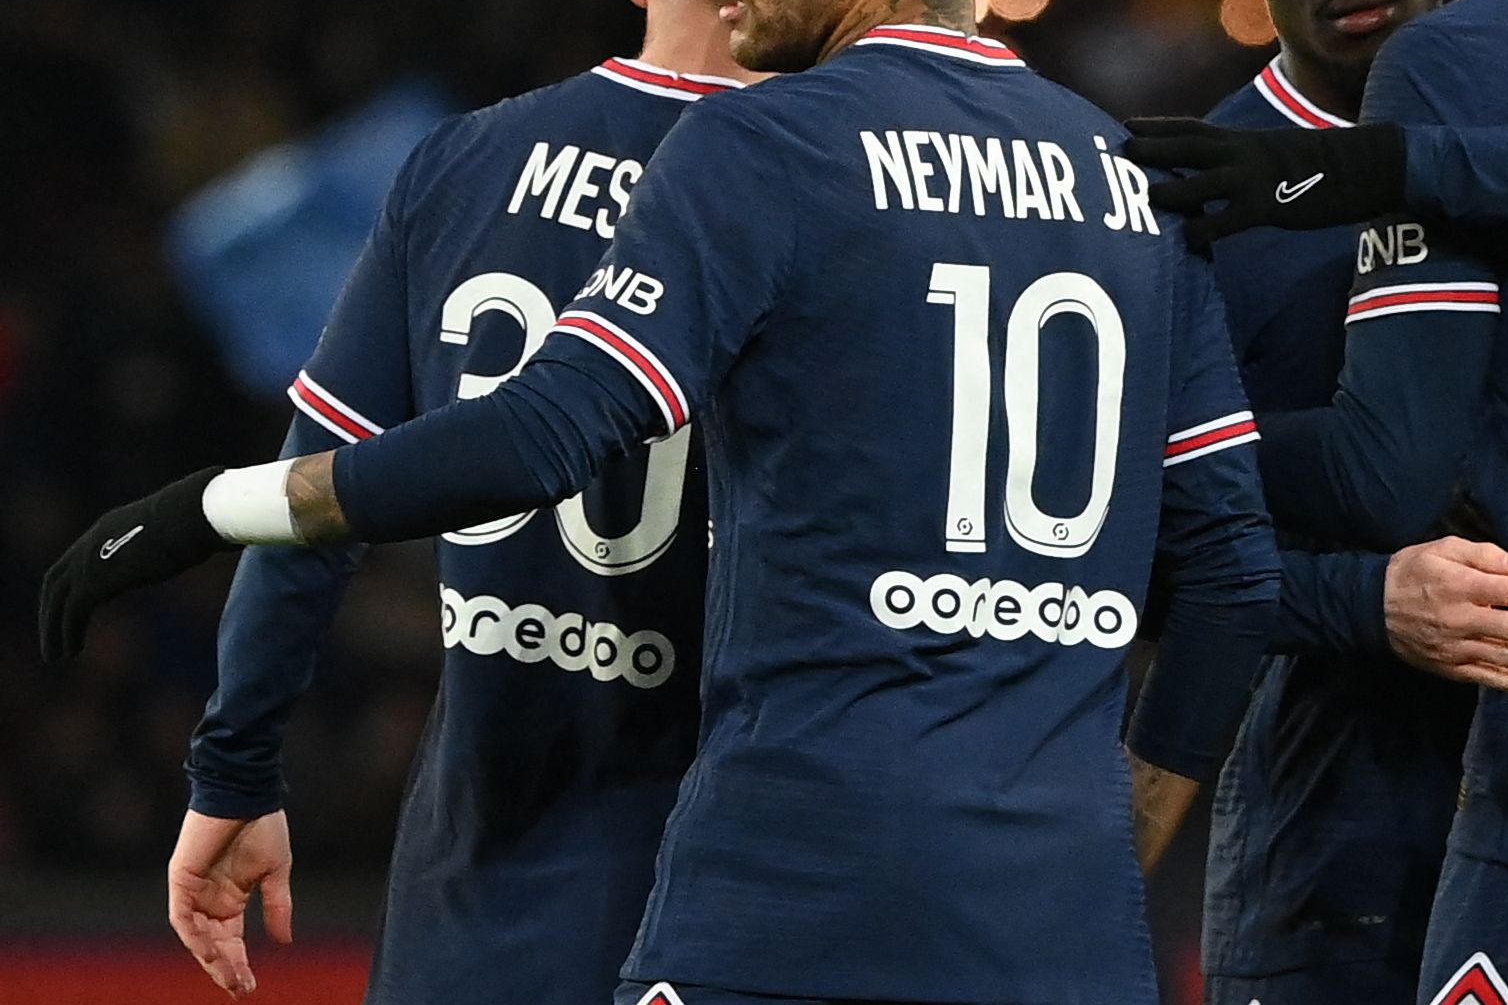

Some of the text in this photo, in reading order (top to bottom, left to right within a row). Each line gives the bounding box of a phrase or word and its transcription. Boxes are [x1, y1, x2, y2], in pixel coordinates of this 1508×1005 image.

[859, 130, 1085, 222] NEYMAR
[1357, 222, 1429, 275] QNB
[926, 263, 1126, 559] 10
[439, 582, 675, 689] oredoo
[870, 570, 1138, 649] ooredoo
